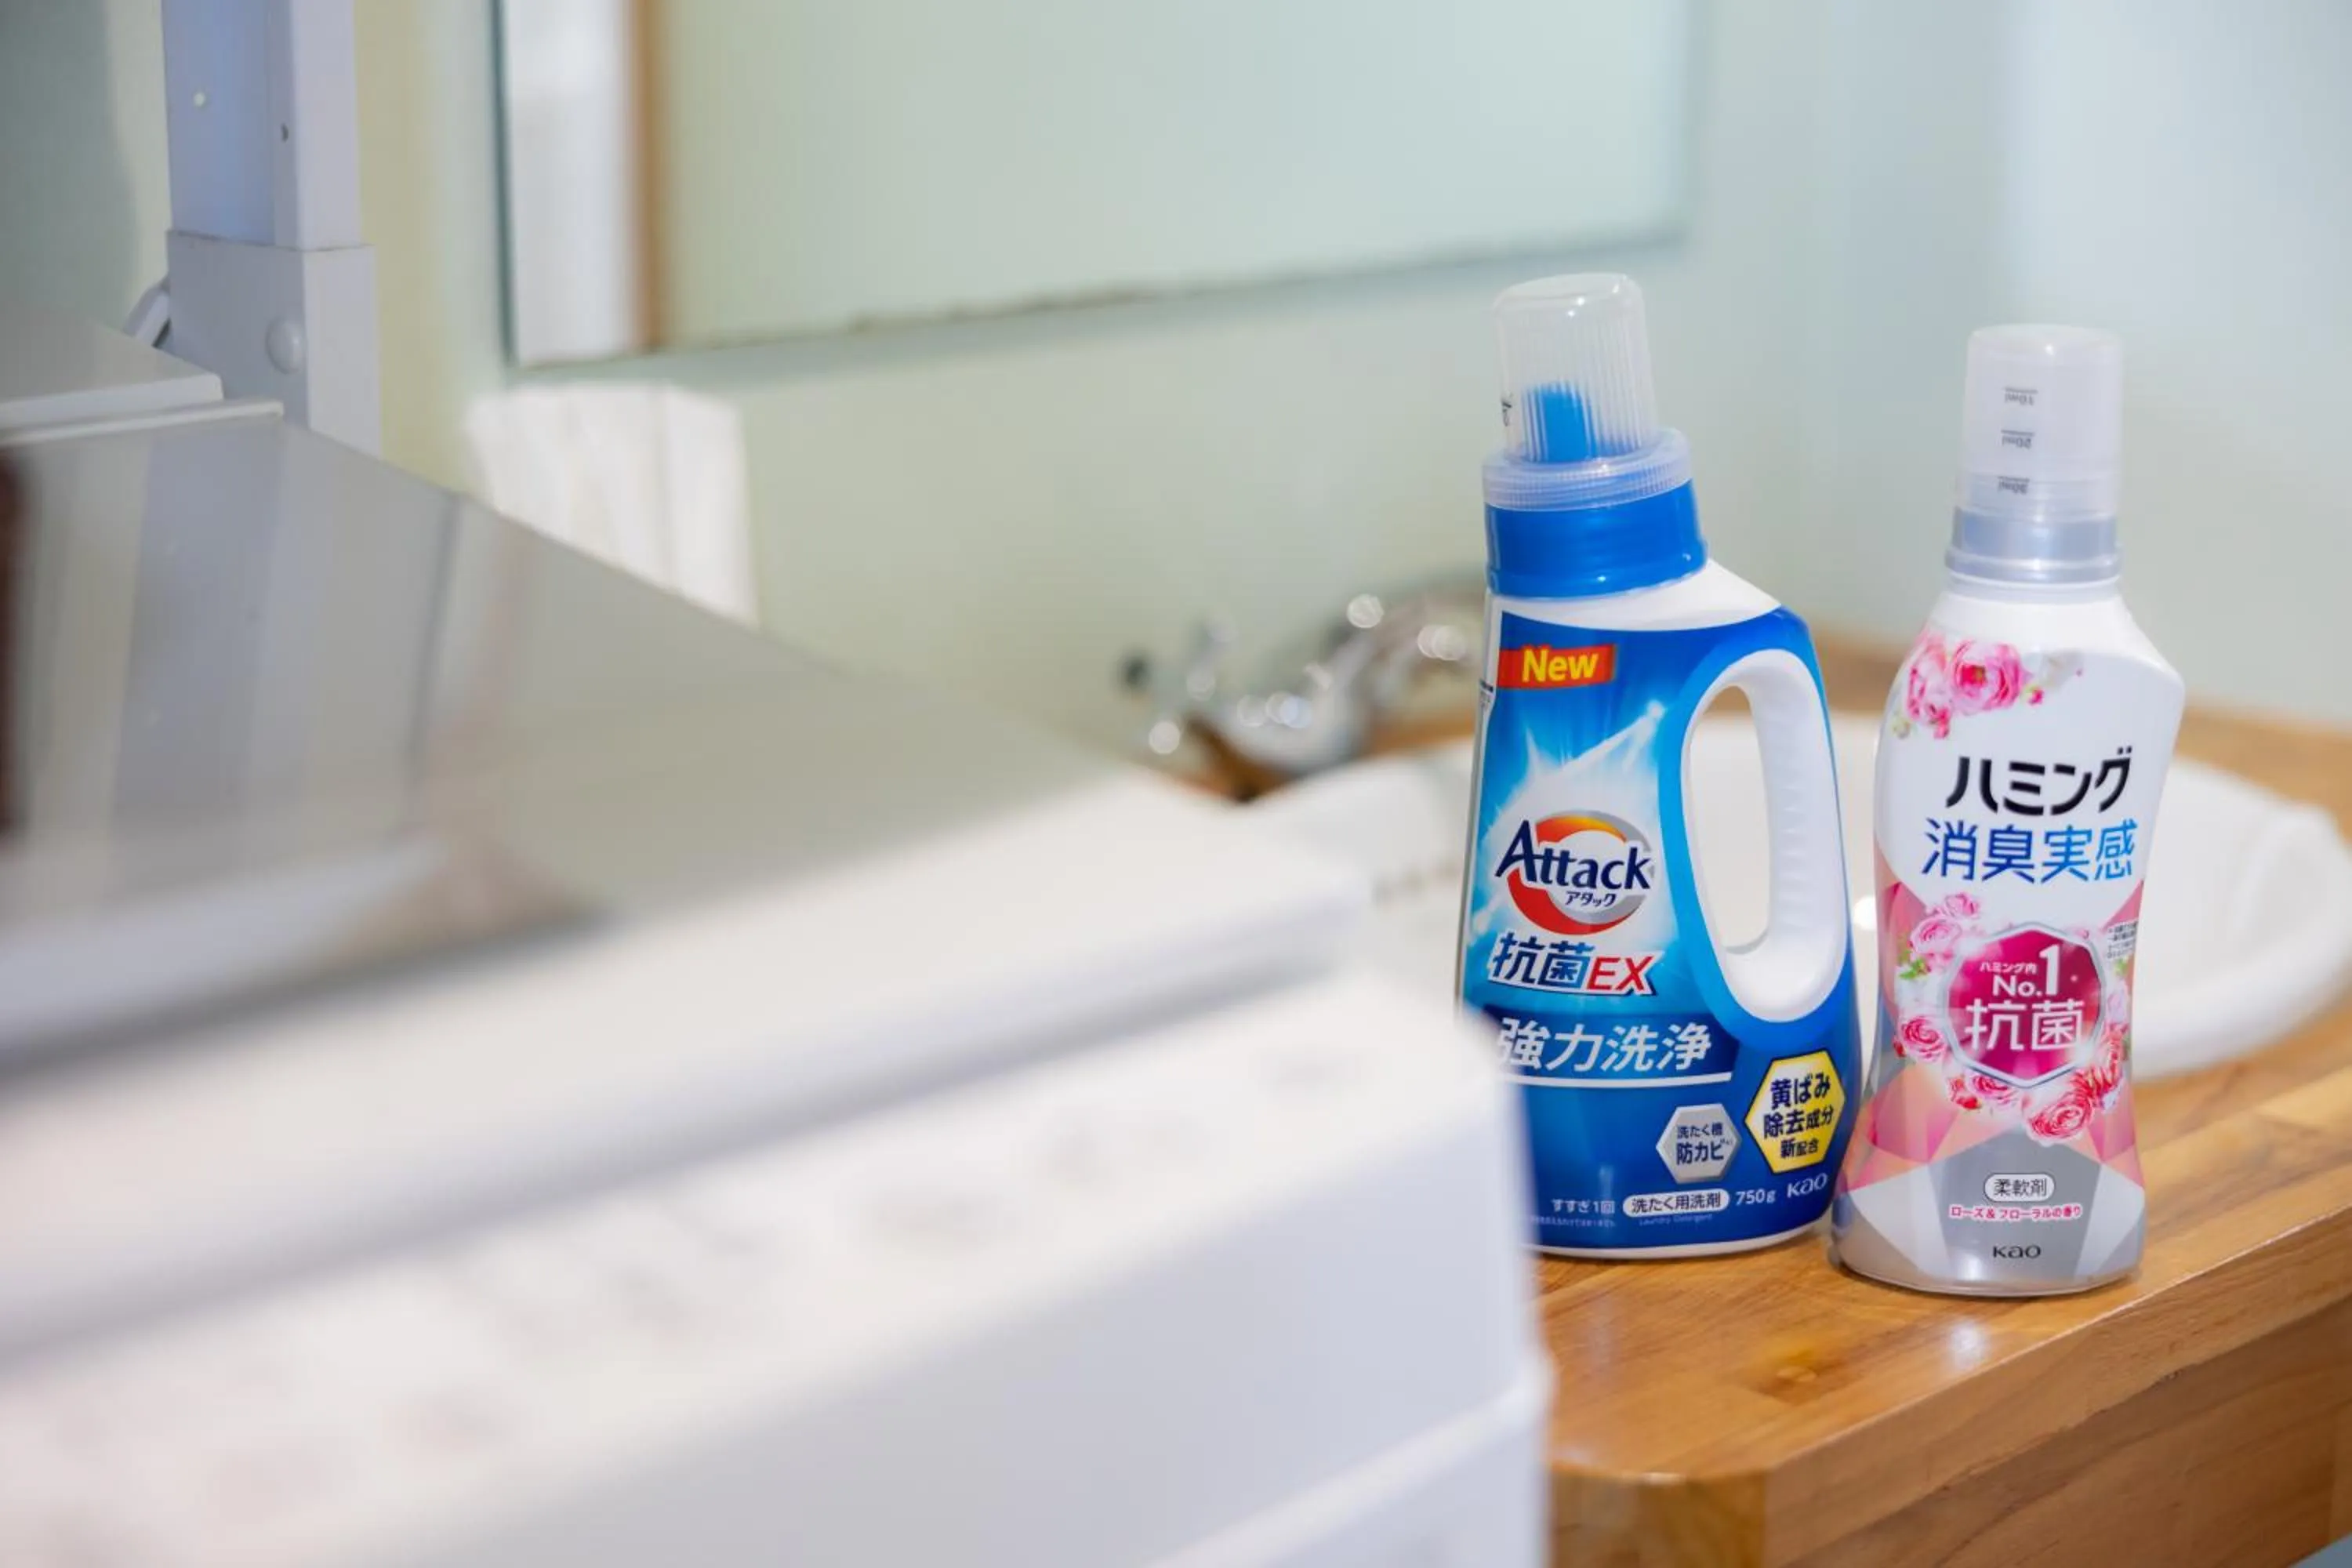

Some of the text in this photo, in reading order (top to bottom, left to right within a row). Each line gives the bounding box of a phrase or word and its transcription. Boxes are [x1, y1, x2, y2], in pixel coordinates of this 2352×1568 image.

[1521, 649, 1599, 682] New
[1946, 746, 2132, 815] ハミング
[1495, 819, 1651, 890] Attack
[1922, 817, 2138, 884] 消臭実感
[1565, 891, 1617, 907] アタック
[1493, 932, 1654, 991] 抗菌EX
[1965, 998, 2085, 1051] 抗菌
[1498, 1017, 1712, 1073] 強力洗浄
[1770, 1072, 1831, 1110] 黄ばみ
[1763, 1105, 1834, 1139] 除去成分
[1780, 1138, 1819, 1158] 新配合
[1631, 1191, 1722, 1214] 洗たく用洗剤
[1994, 1178, 2047, 1196] 柔軟剤
